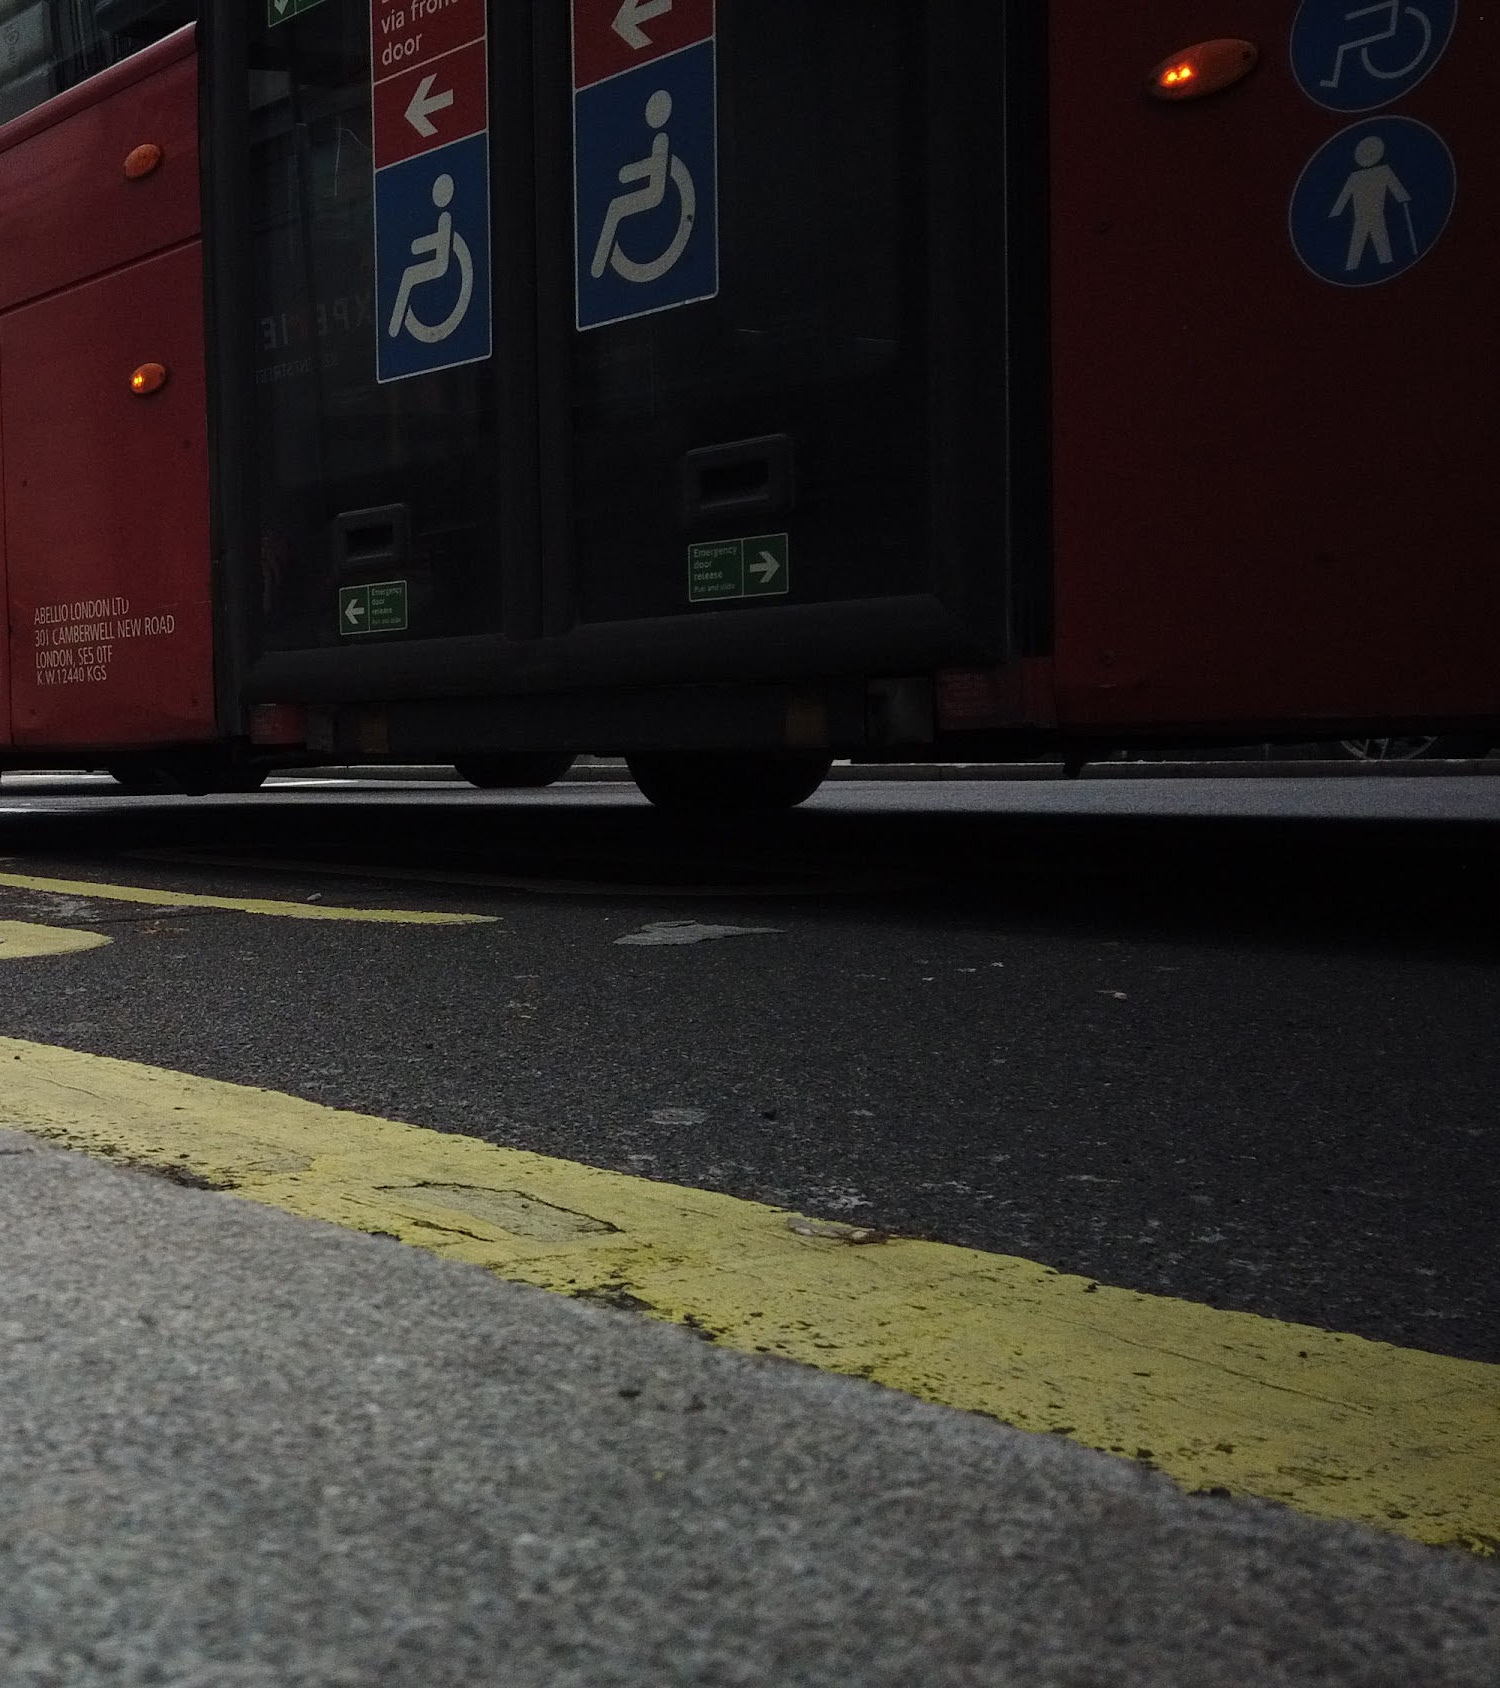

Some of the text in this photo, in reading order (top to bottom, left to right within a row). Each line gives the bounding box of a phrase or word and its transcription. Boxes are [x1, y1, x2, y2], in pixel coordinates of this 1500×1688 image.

[381, 8, 405, 34] via
[381, 33, 423, 66] door
[693, 545, 738, 559] Emergency
[693, 560, 713, 570] door
[693, 570, 724, 581] release
[371, 587, 403, 597] Emergency
[33, 596, 130, 626] ABELLIO LONDON LTD
[371, 598, 385, 606] door
[35, 614, 176, 648] 301 CAMBERWELL NEW ROAD
[35, 648, 76, 669] LONDON,
[77, 646, 94, 666] SE5
[86, 664, 107, 682] KGS
